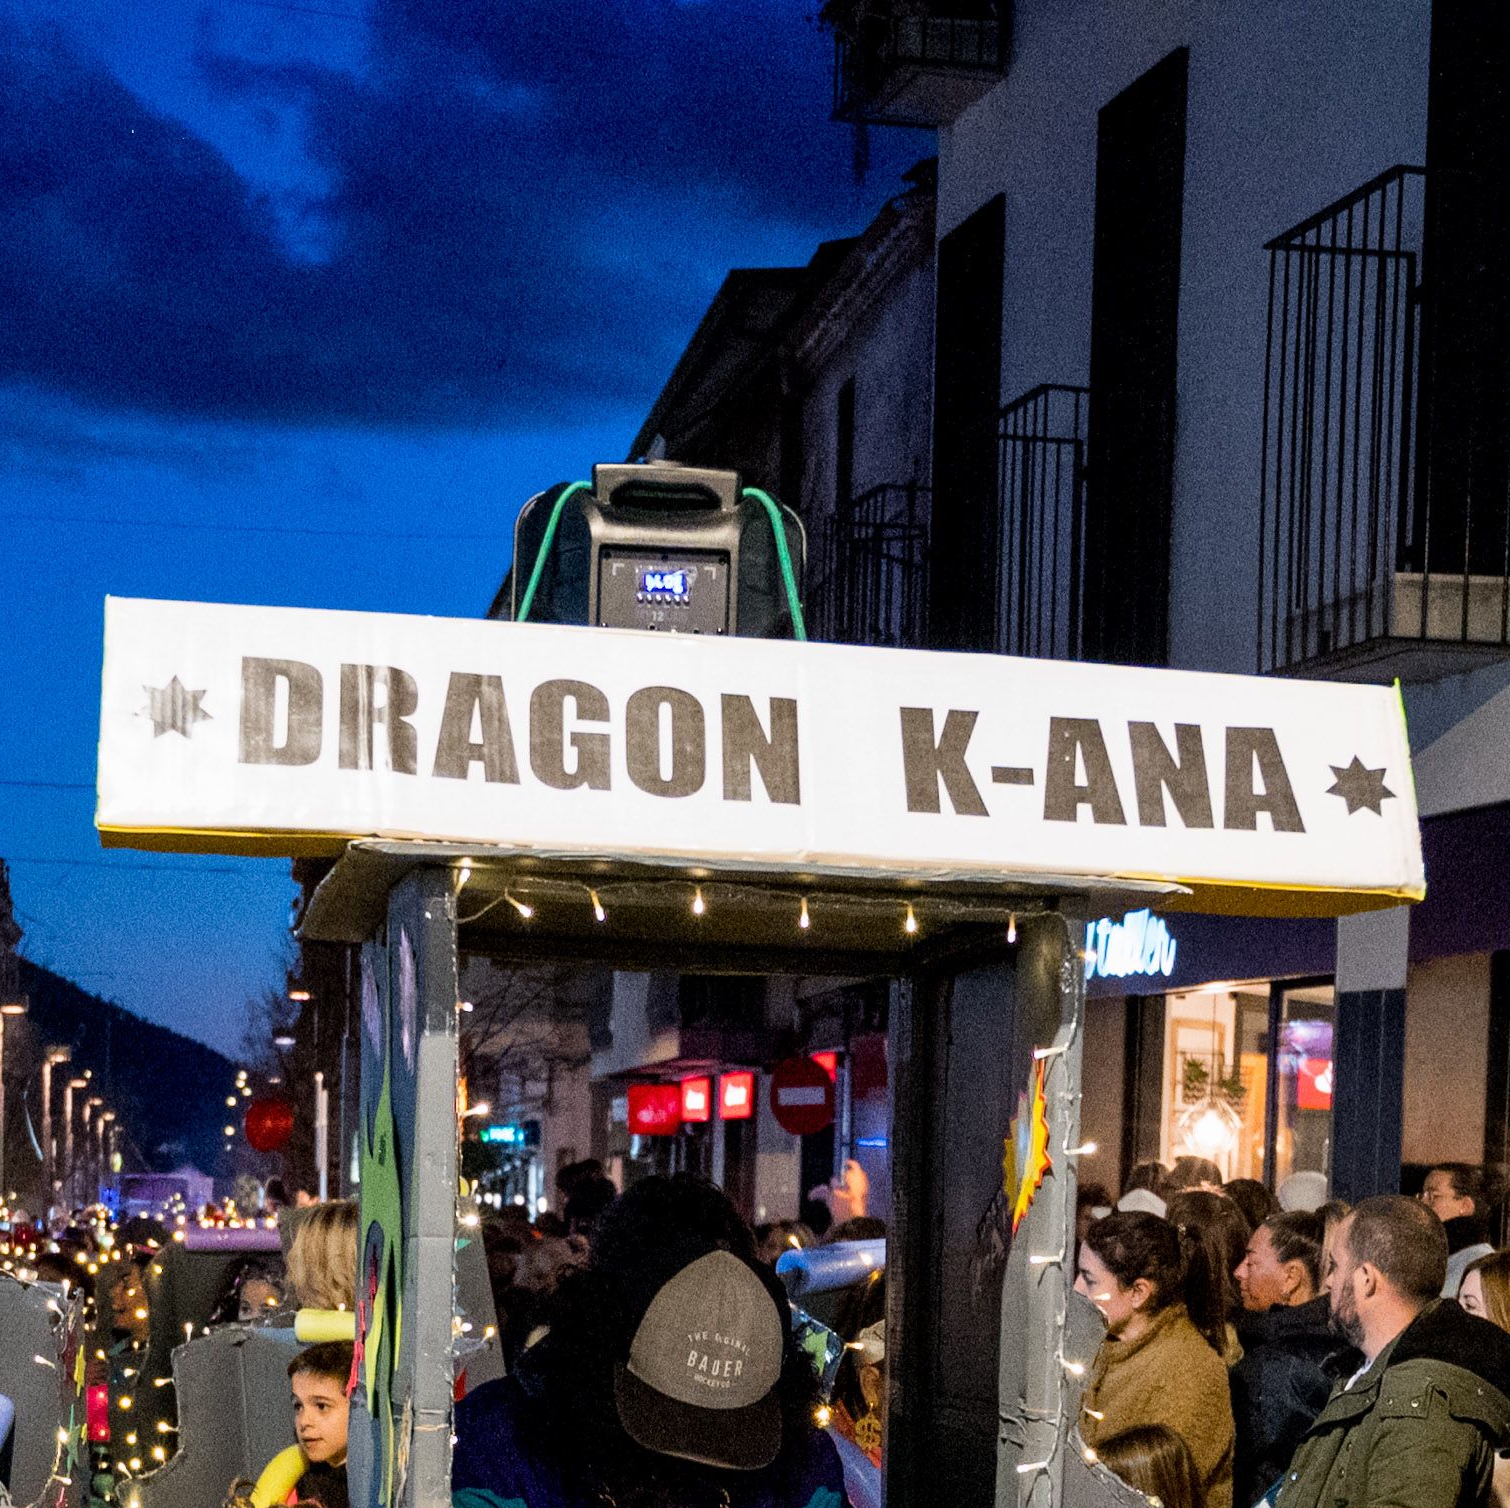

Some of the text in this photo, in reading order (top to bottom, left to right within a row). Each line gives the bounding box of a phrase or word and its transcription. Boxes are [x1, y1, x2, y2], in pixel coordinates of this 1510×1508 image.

[238, 656, 1307, 834] DRAGON K-ANA
[687, 1350, 743, 1377] BAUER
